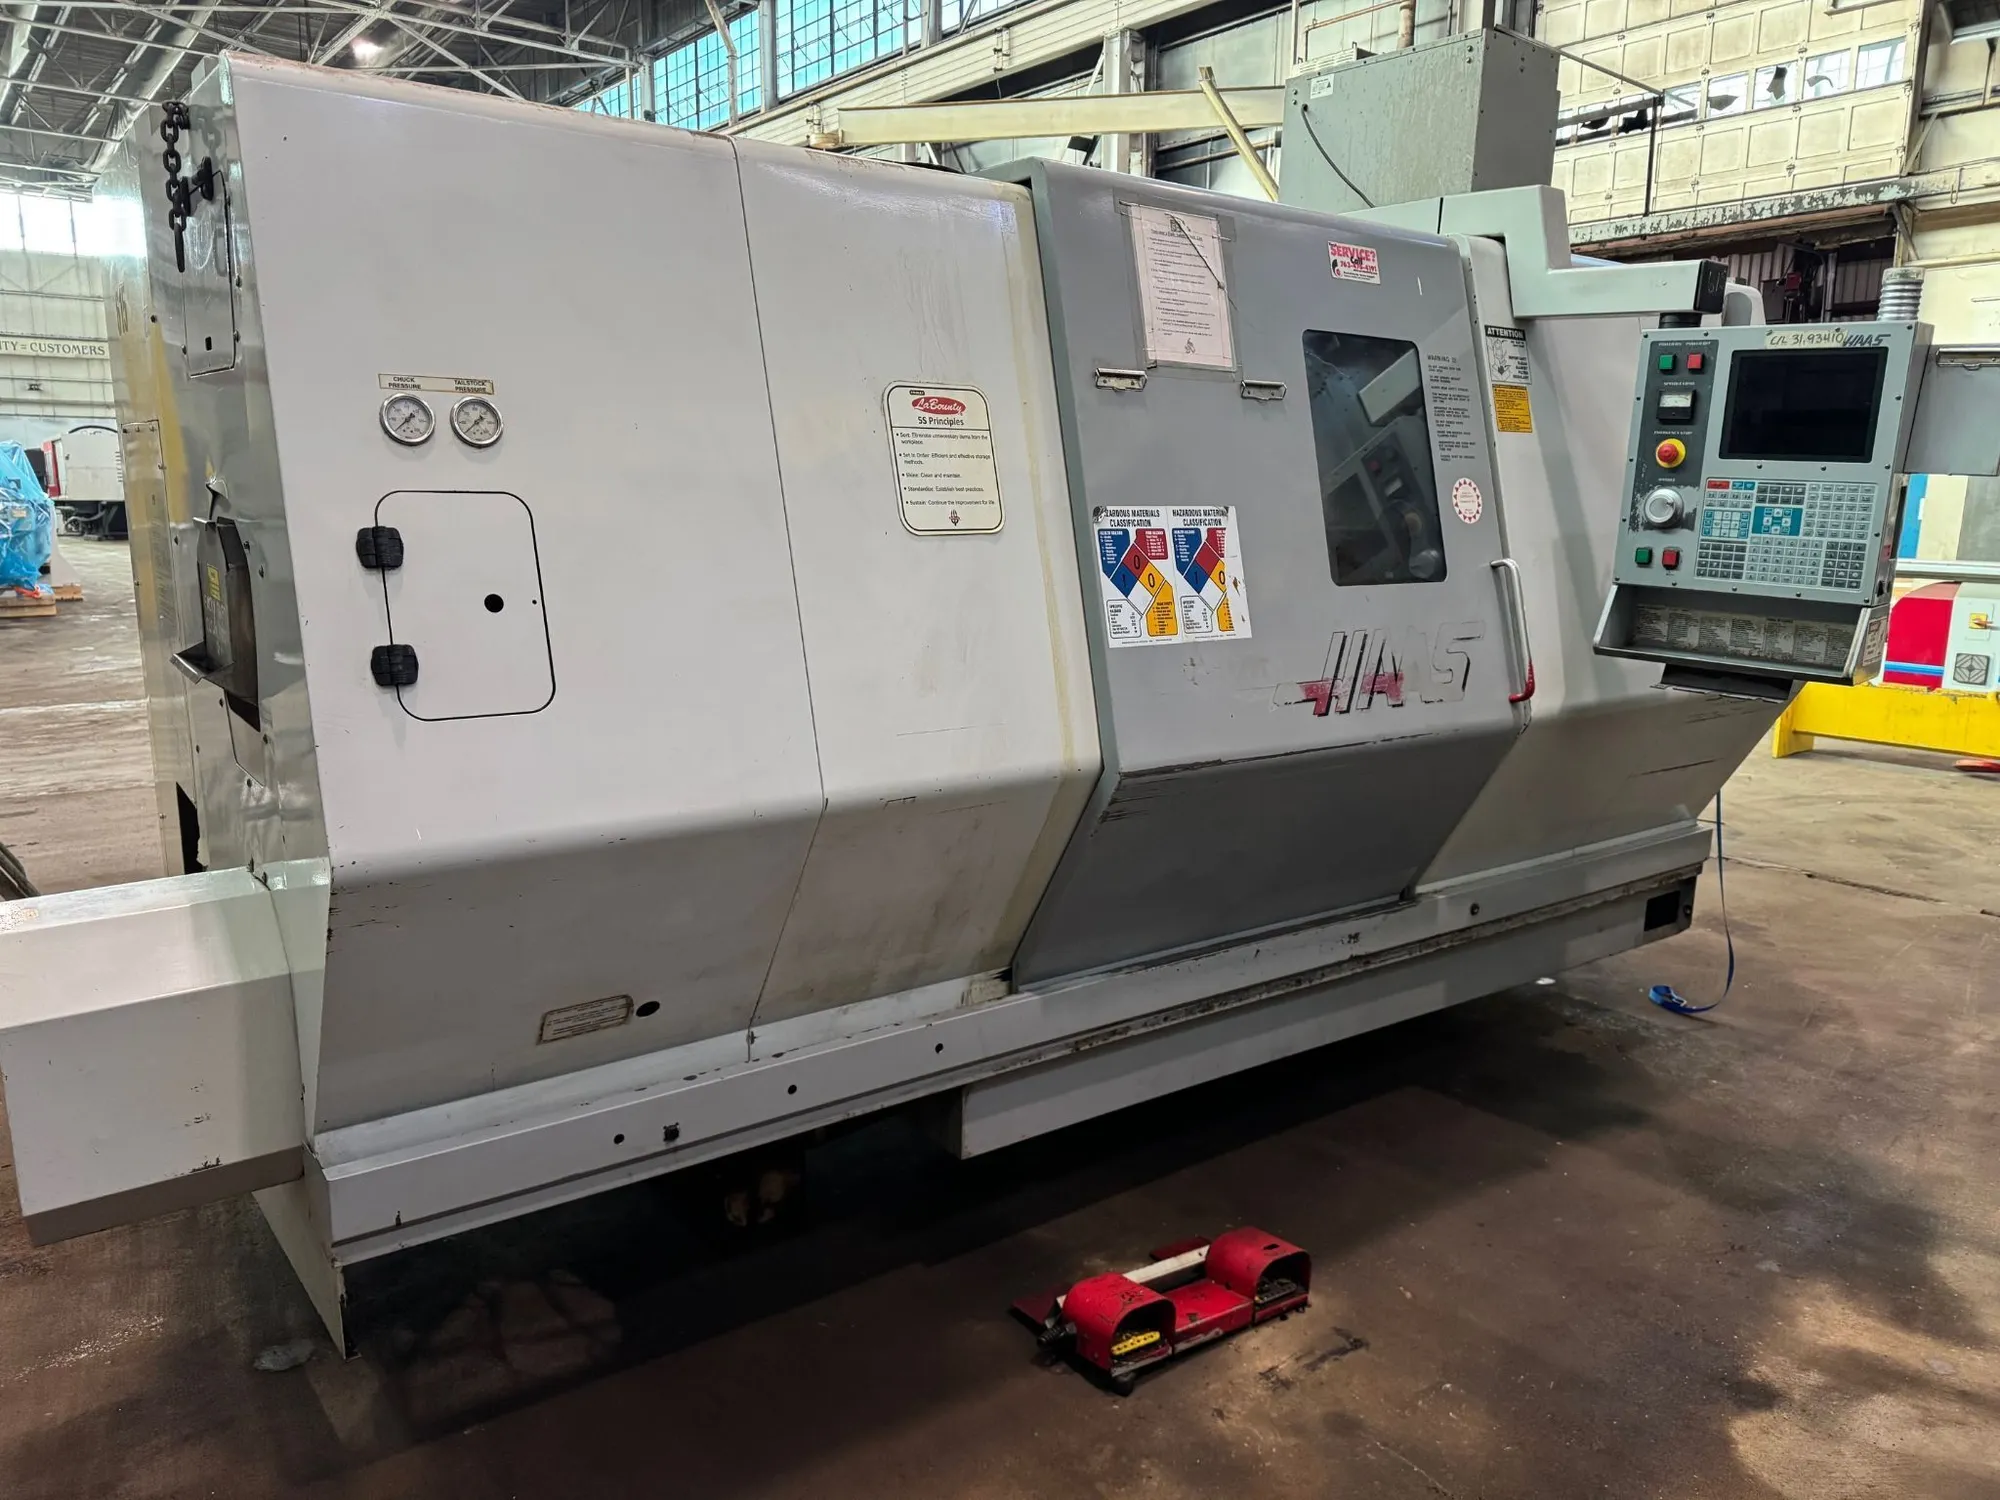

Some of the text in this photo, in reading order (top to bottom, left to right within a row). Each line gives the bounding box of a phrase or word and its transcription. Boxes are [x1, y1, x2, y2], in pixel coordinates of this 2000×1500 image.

[1331, 245, 1376, 262] SERVICE?
[1350, 256, 1362, 265] Call
[1487, 327, 1524, 339] ATTENTION
[30, 342, 106, 356] CUSTOMERS
[388, 382, 421, 390] PRESSURE
[454, 379, 487, 387] TAILSTOCK
[914, 397, 963, 414] LaBounty
[929, 416, 965, 428] Principles
[1131, 509, 1160, 517] MATERIALS
[1172, 509, 1202, 517] HAZARDOUS
[1109, 518, 1152, 527] CLASSIFICATION
[1183, 518, 1222, 527] CLASSIFICATION
[1133, 554, 1141, 570] 0
[1148, 572, 1156, 588] 0
[1219, 570, 1226, 585] 0
